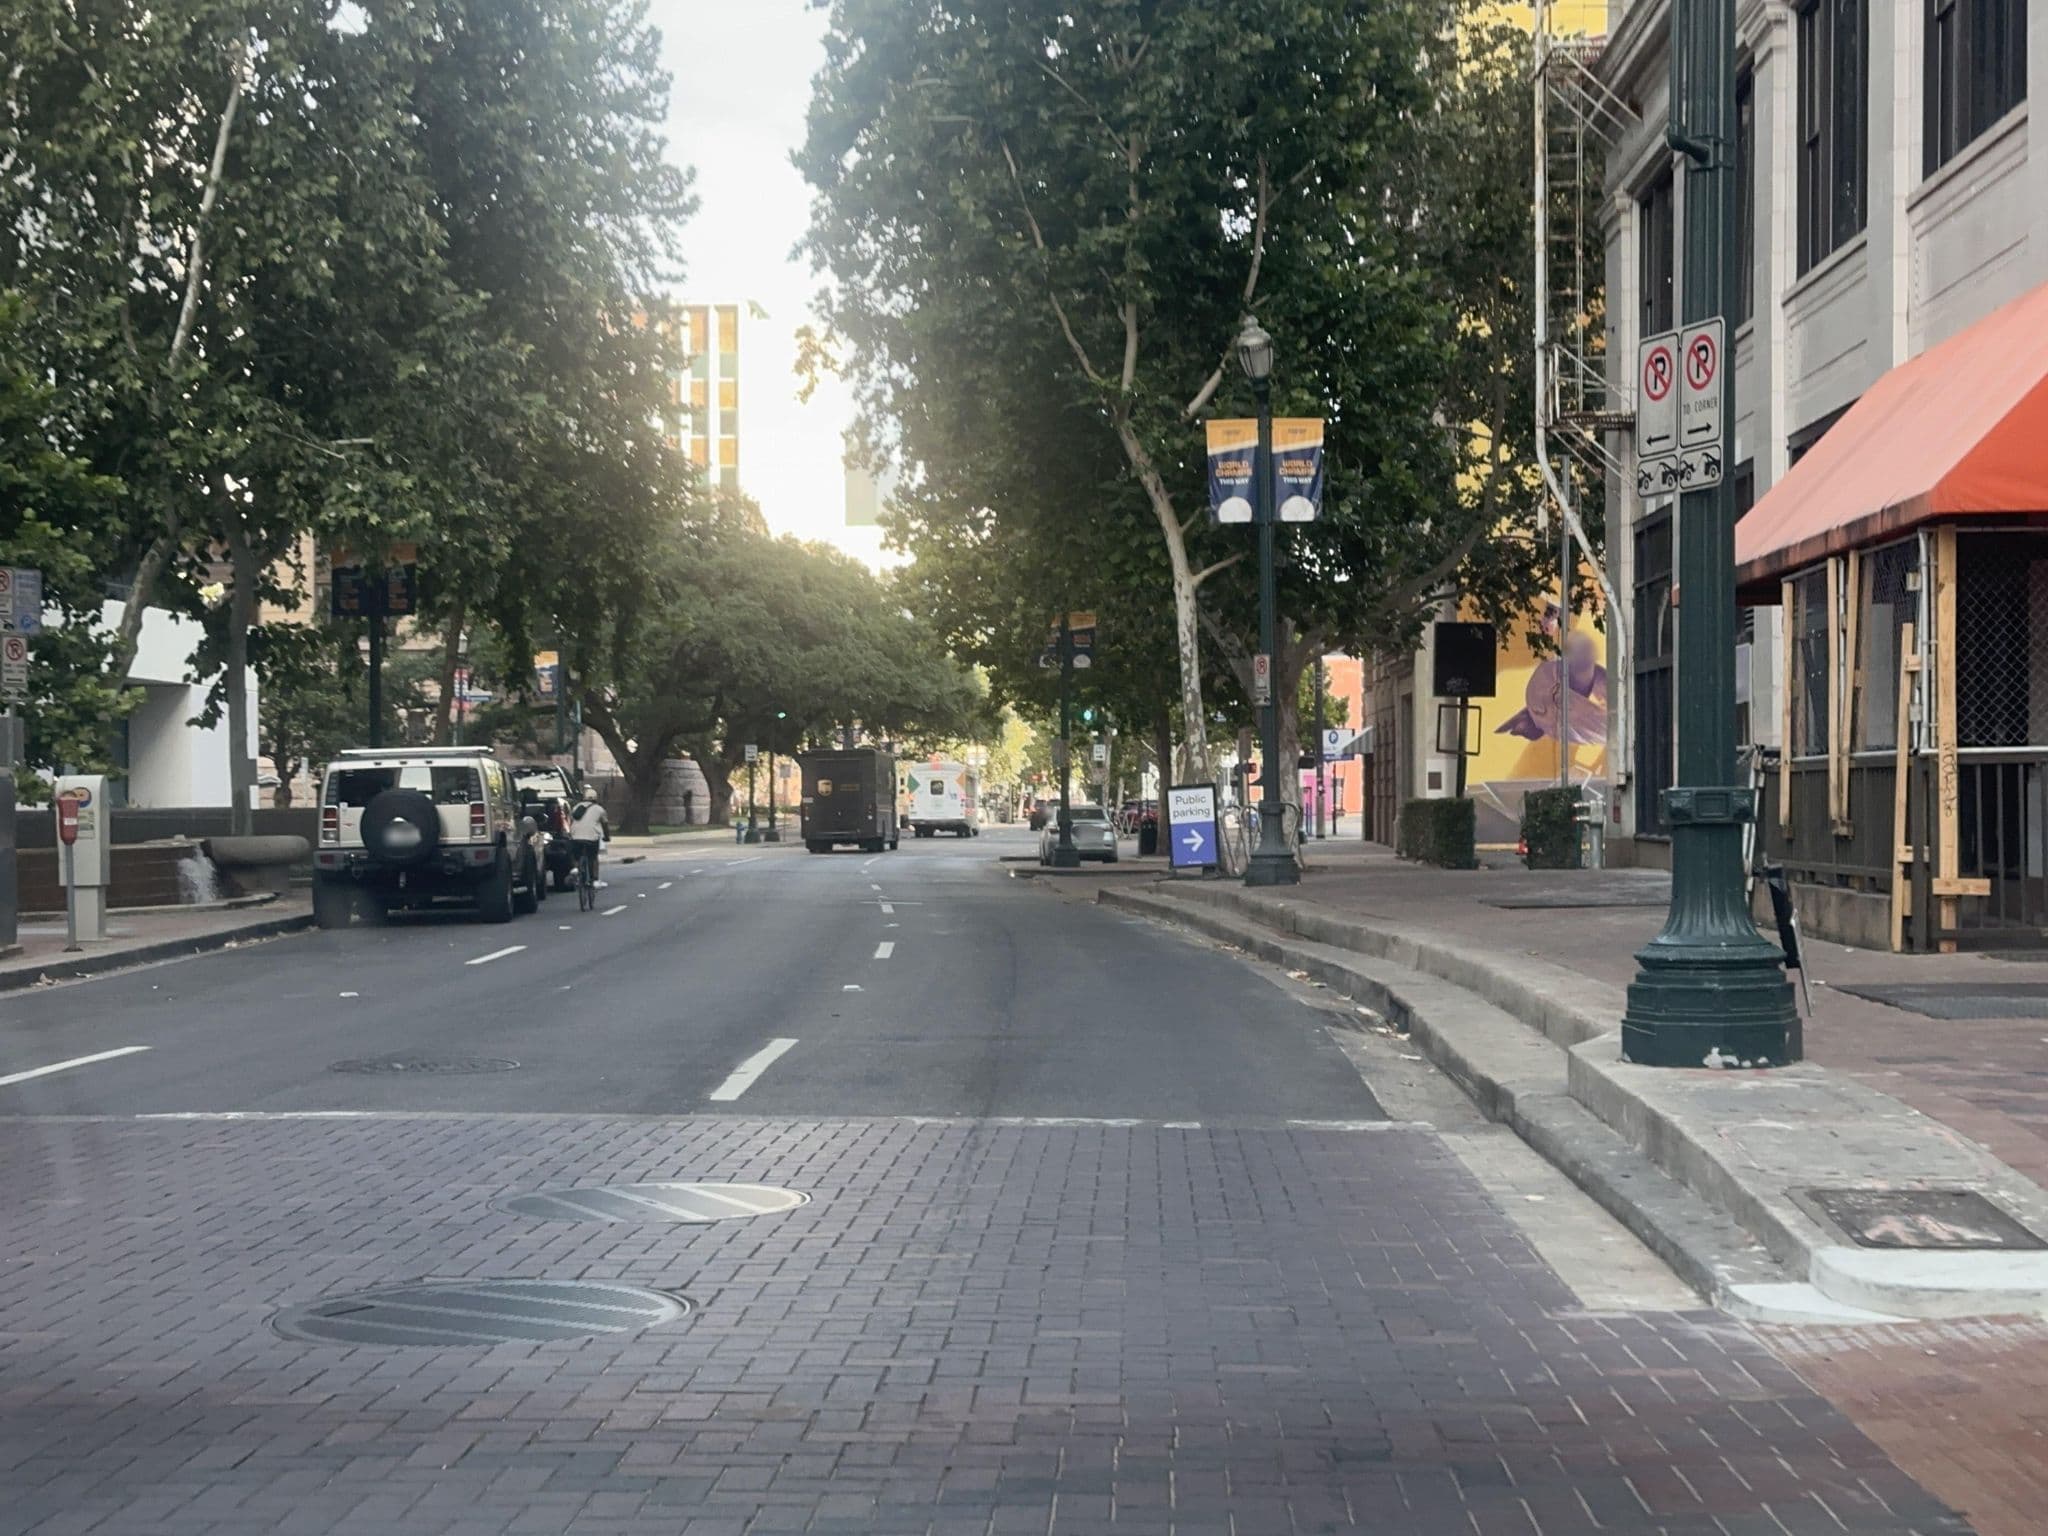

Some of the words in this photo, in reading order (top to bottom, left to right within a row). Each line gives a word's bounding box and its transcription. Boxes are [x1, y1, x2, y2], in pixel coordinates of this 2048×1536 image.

[1682, 403, 1691, 416] TO
[1694, 397, 1718, 413] CORNER
[1235, 477, 1249, 485] WAY
[1299, 476, 1313, 484] WAY
[1175, 795, 1207, 806] Public
[1172, 808, 1211, 819] parking
